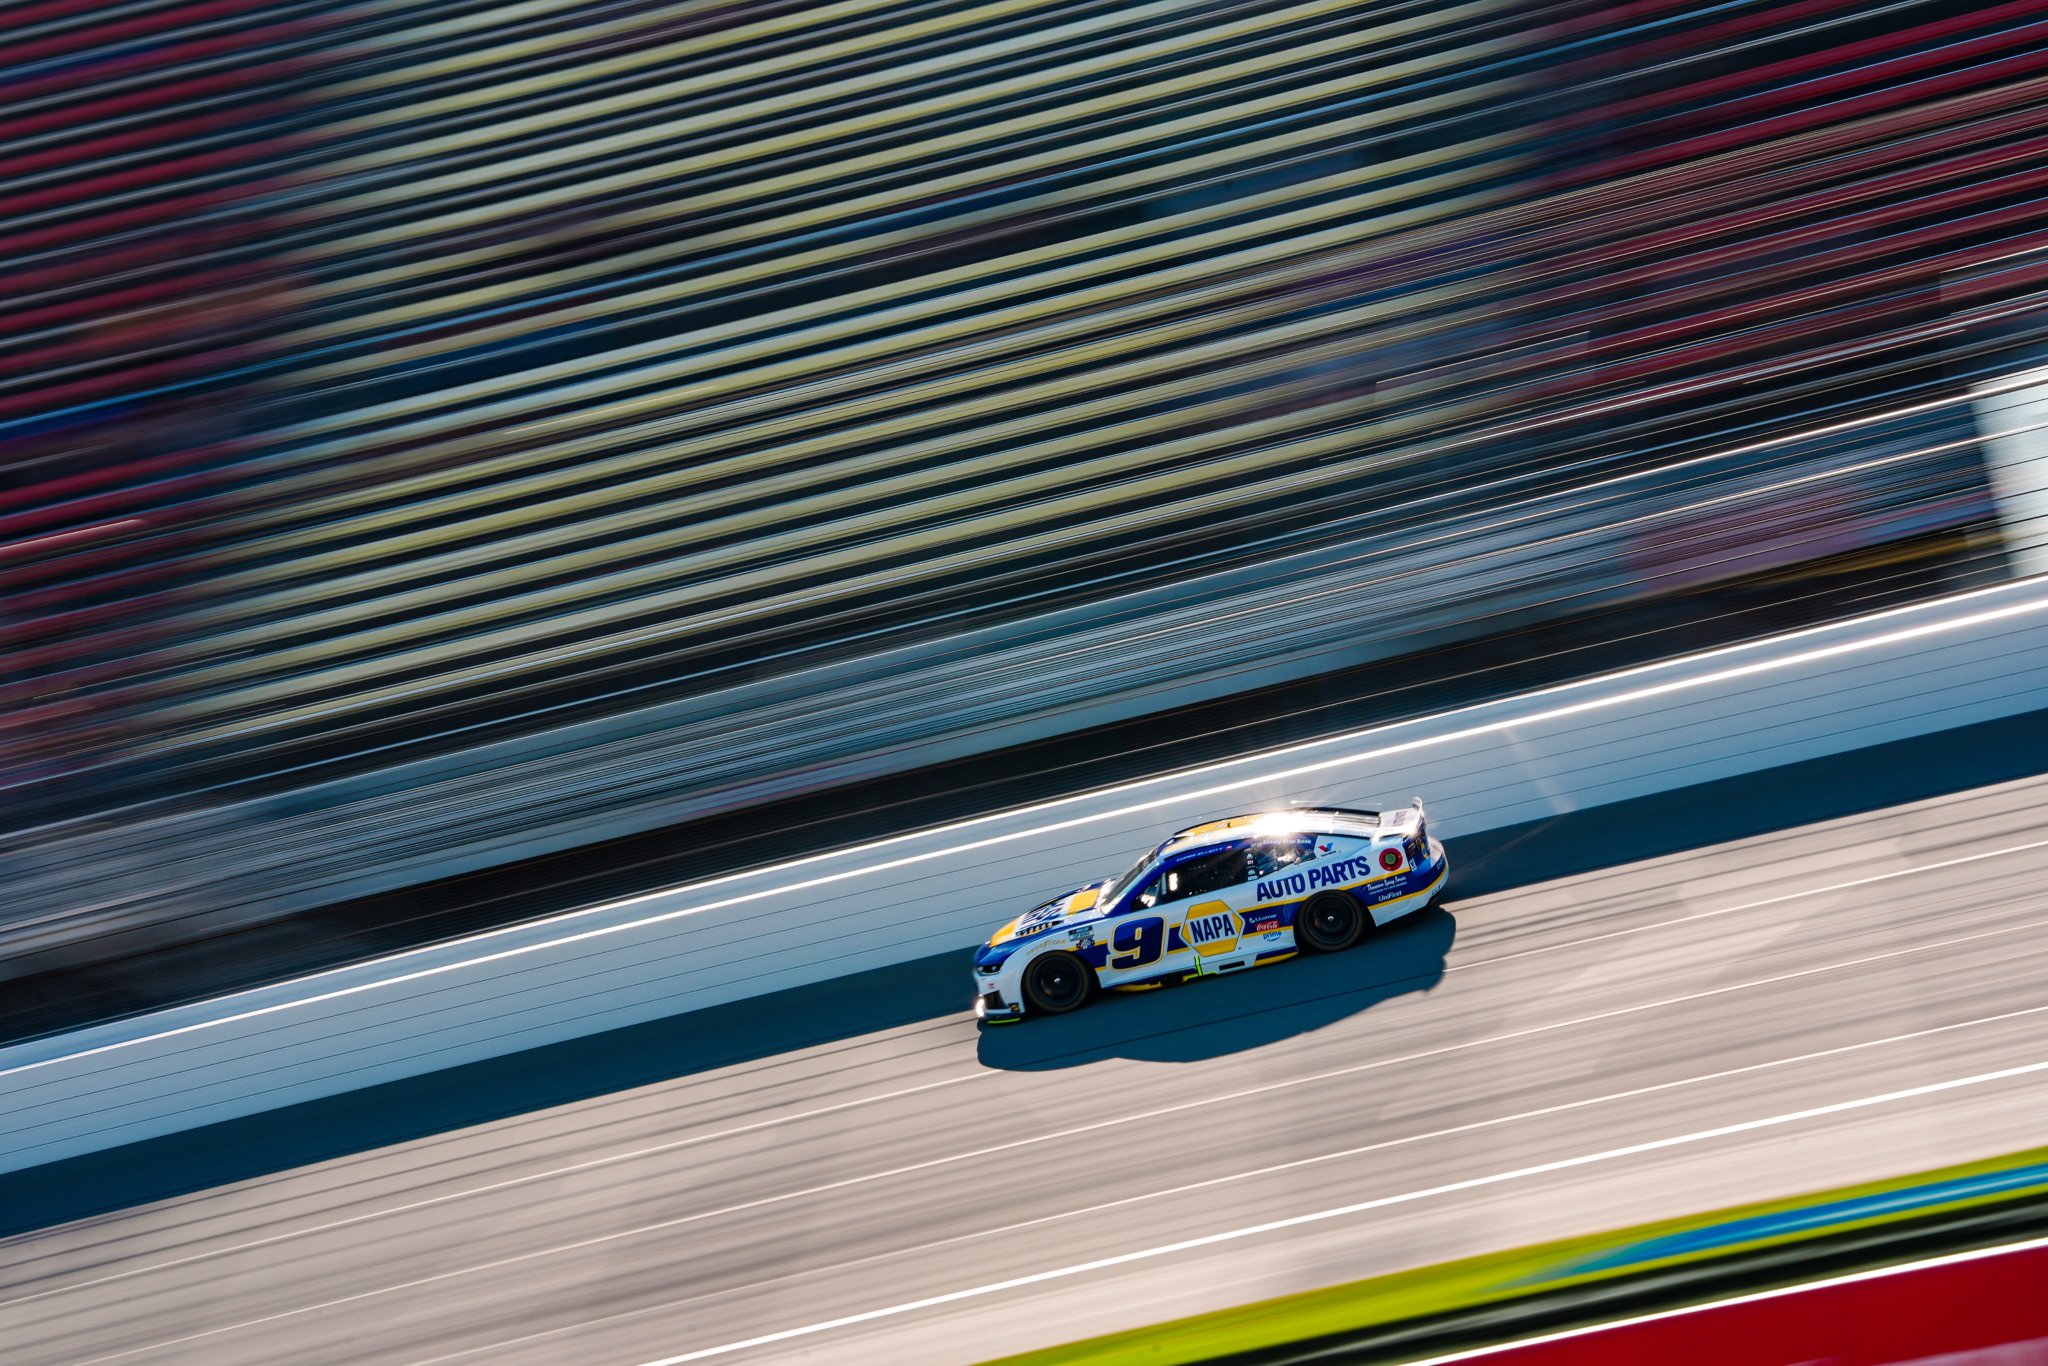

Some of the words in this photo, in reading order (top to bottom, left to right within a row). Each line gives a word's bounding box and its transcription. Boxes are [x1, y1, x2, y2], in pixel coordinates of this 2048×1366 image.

[1256, 873, 1306, 902] AUTO
[1307, 855, 1371, 890] PARTS
[1378, 890, 1402, 902] UniFirst
[1111, 915, 1165, 971] 9
[1190, 913, 1235, 943] NAPA
[1262, 931, 1282, 940] prime
